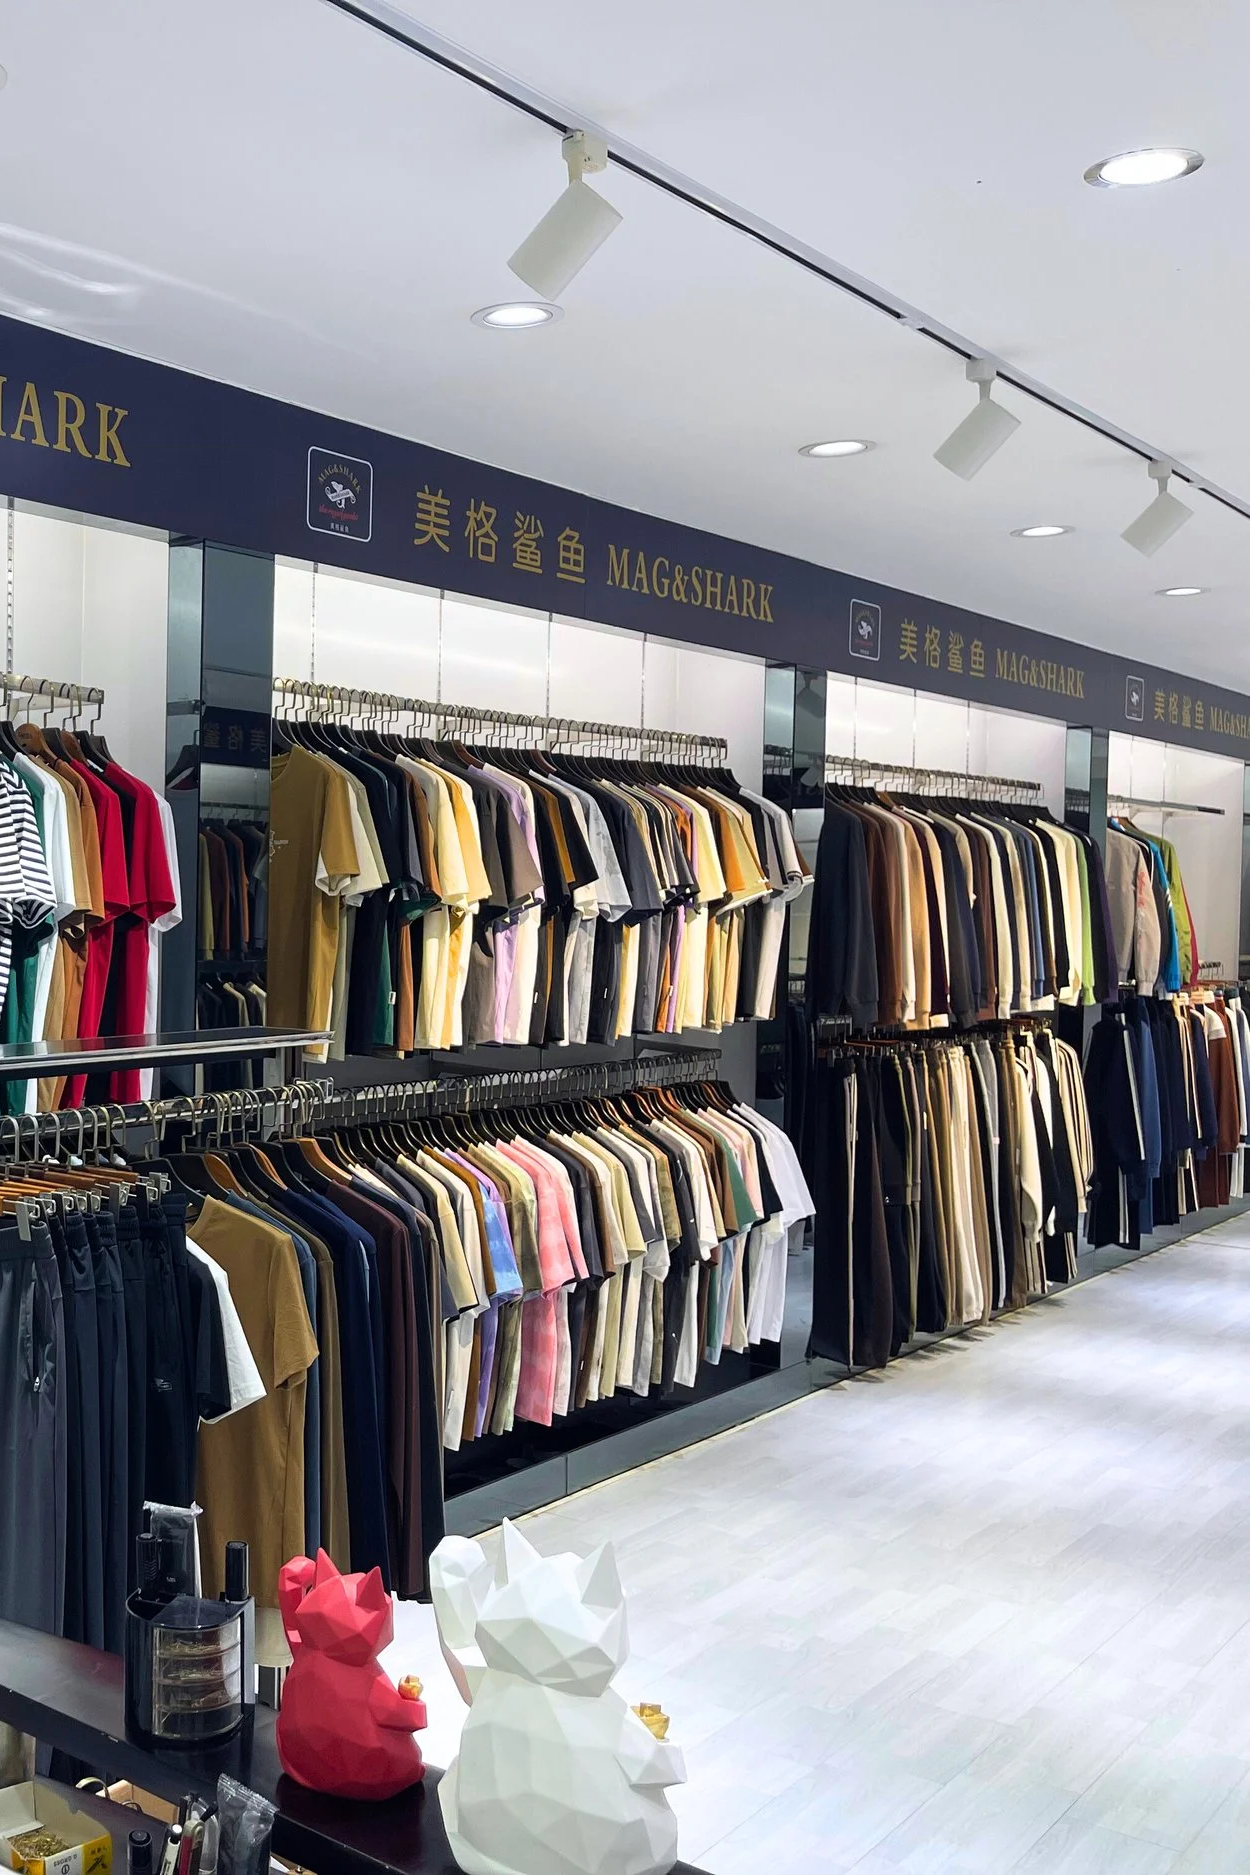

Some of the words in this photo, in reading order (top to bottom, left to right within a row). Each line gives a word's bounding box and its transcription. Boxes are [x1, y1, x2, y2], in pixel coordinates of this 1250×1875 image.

[413, 484, 586, 585] 美格鲨鱼
[606, 543, 774, 623] MAG&SHARK
[899, 618, 986, 679] 美格鲨鱼
[995, 648, 1085, 699] MAG&SHARK
